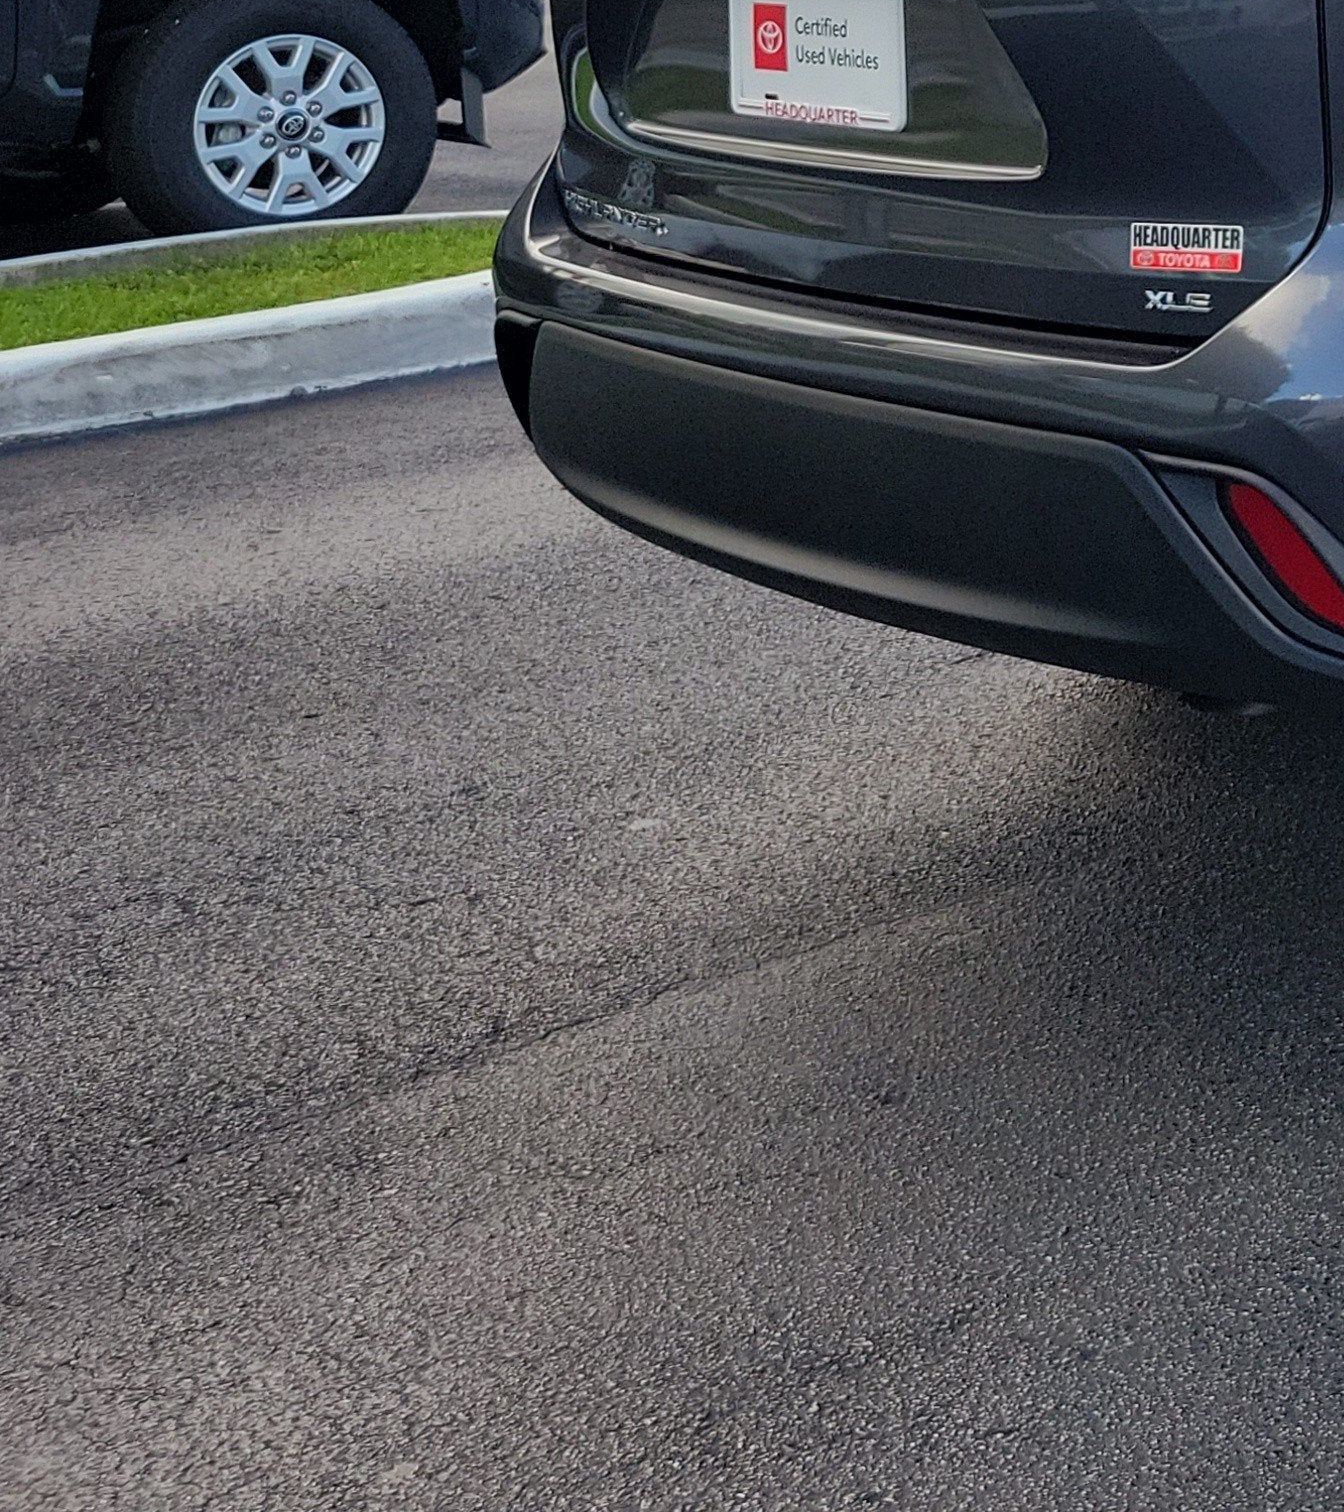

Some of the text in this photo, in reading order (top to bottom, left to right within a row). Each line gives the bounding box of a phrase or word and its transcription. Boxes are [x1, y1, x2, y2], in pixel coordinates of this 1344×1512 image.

[794, 15, 848, 38] Certified
[795, 45, 879, 70] Used Vehicles
[765, 100, 859, 125] HEADQUARTER
[1133, 224, 1241, 249] HEADQUARTER
[1158, 252, 1212, 268] TOYOTA
[1144, 289, 1214, 313] XLE
